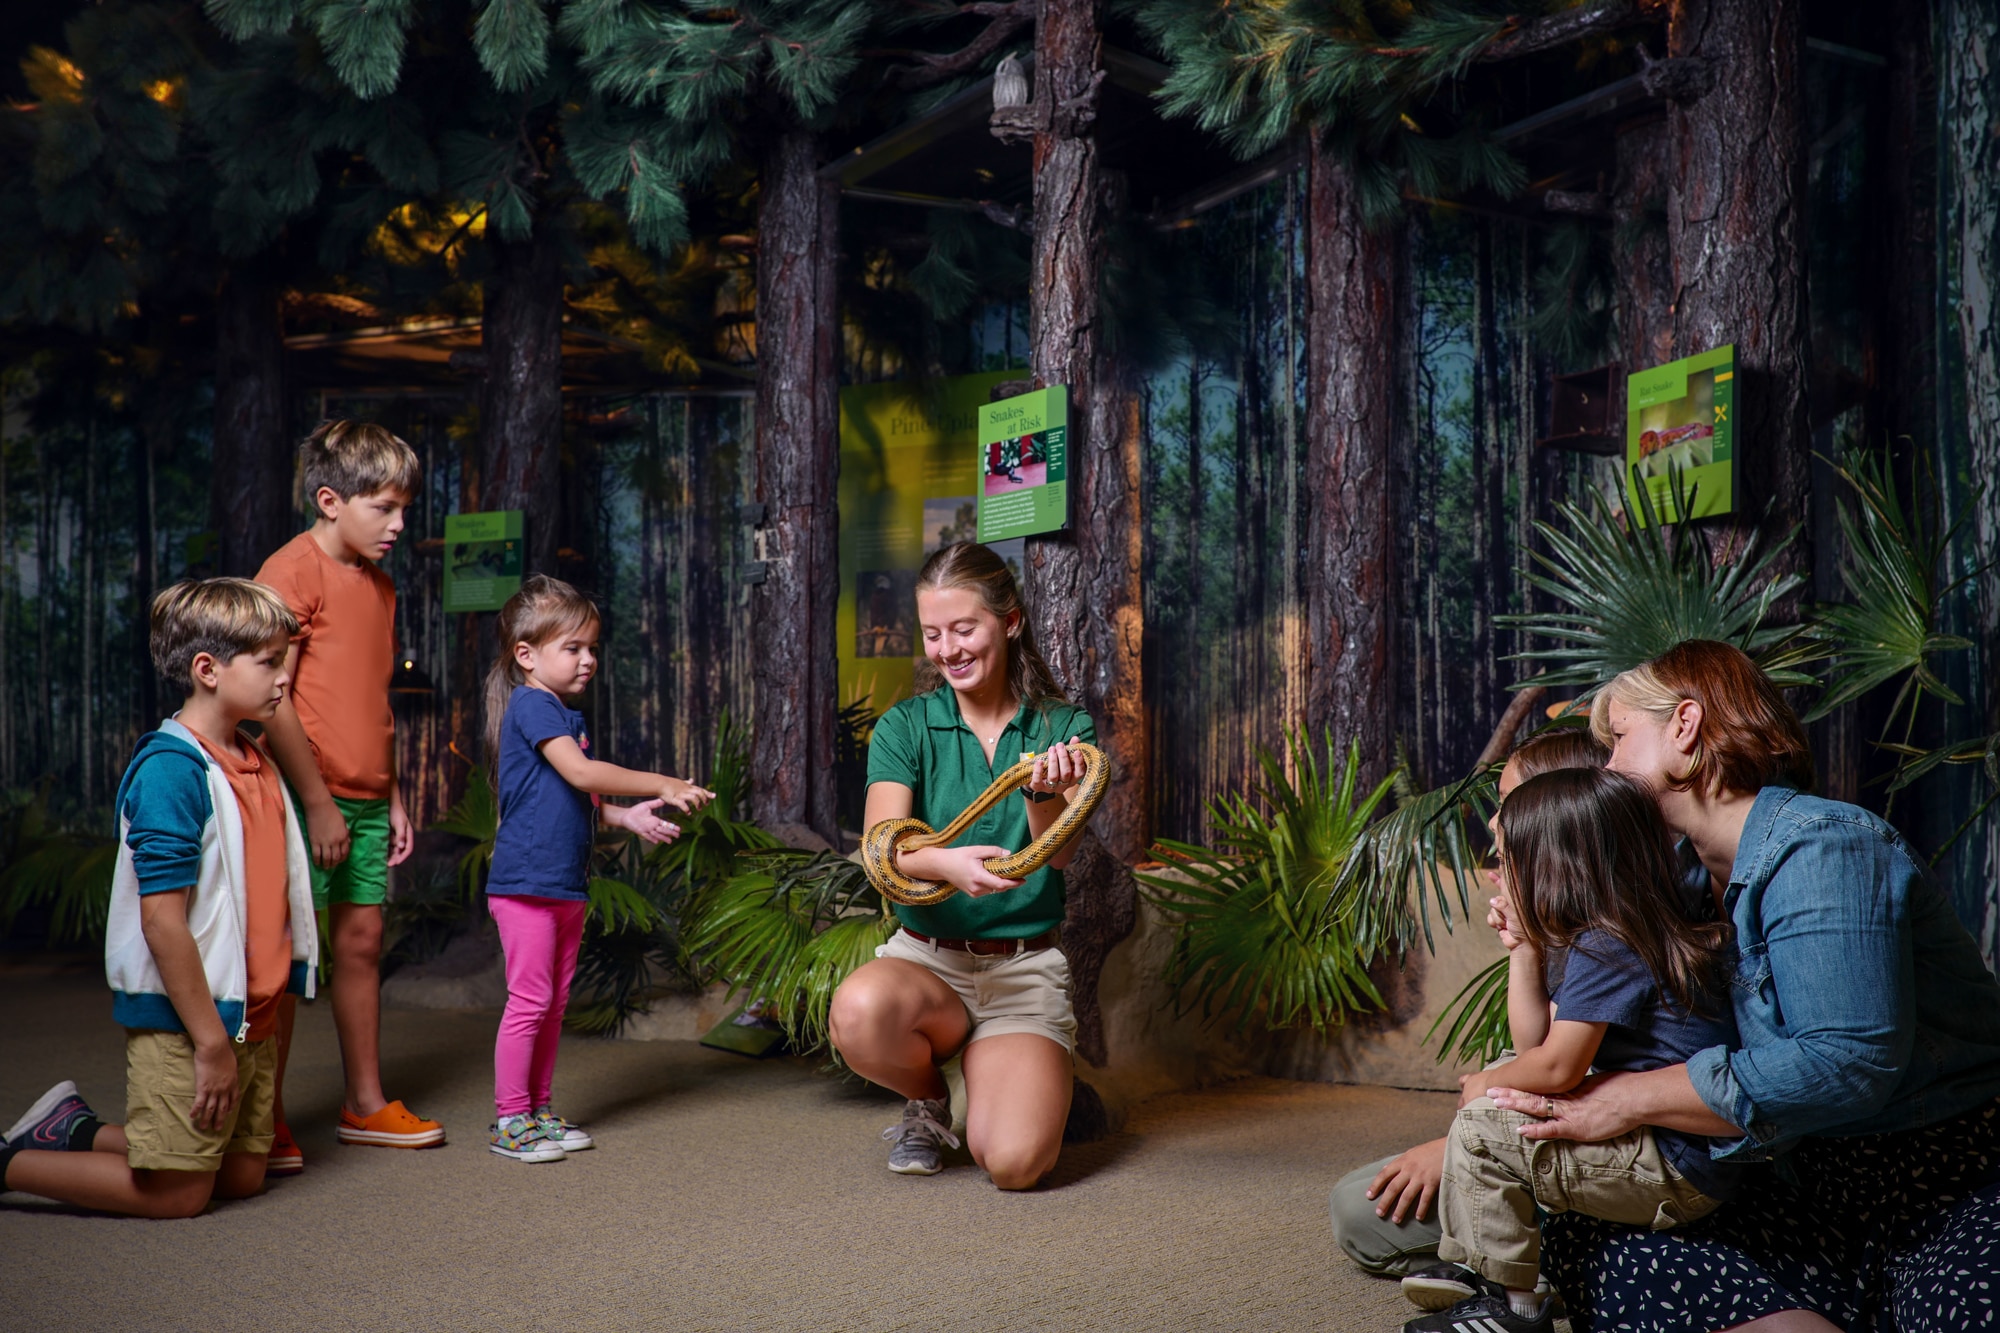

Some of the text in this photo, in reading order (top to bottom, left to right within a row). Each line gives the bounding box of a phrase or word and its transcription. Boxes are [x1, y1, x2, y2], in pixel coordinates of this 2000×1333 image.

[1653, 379, 1675, 393] Snake
[891, 412, 978, 435] Pine Upla
[990, 407, 1025, 424] Snakes
[1007, 414, 1042, 435] at Risk
